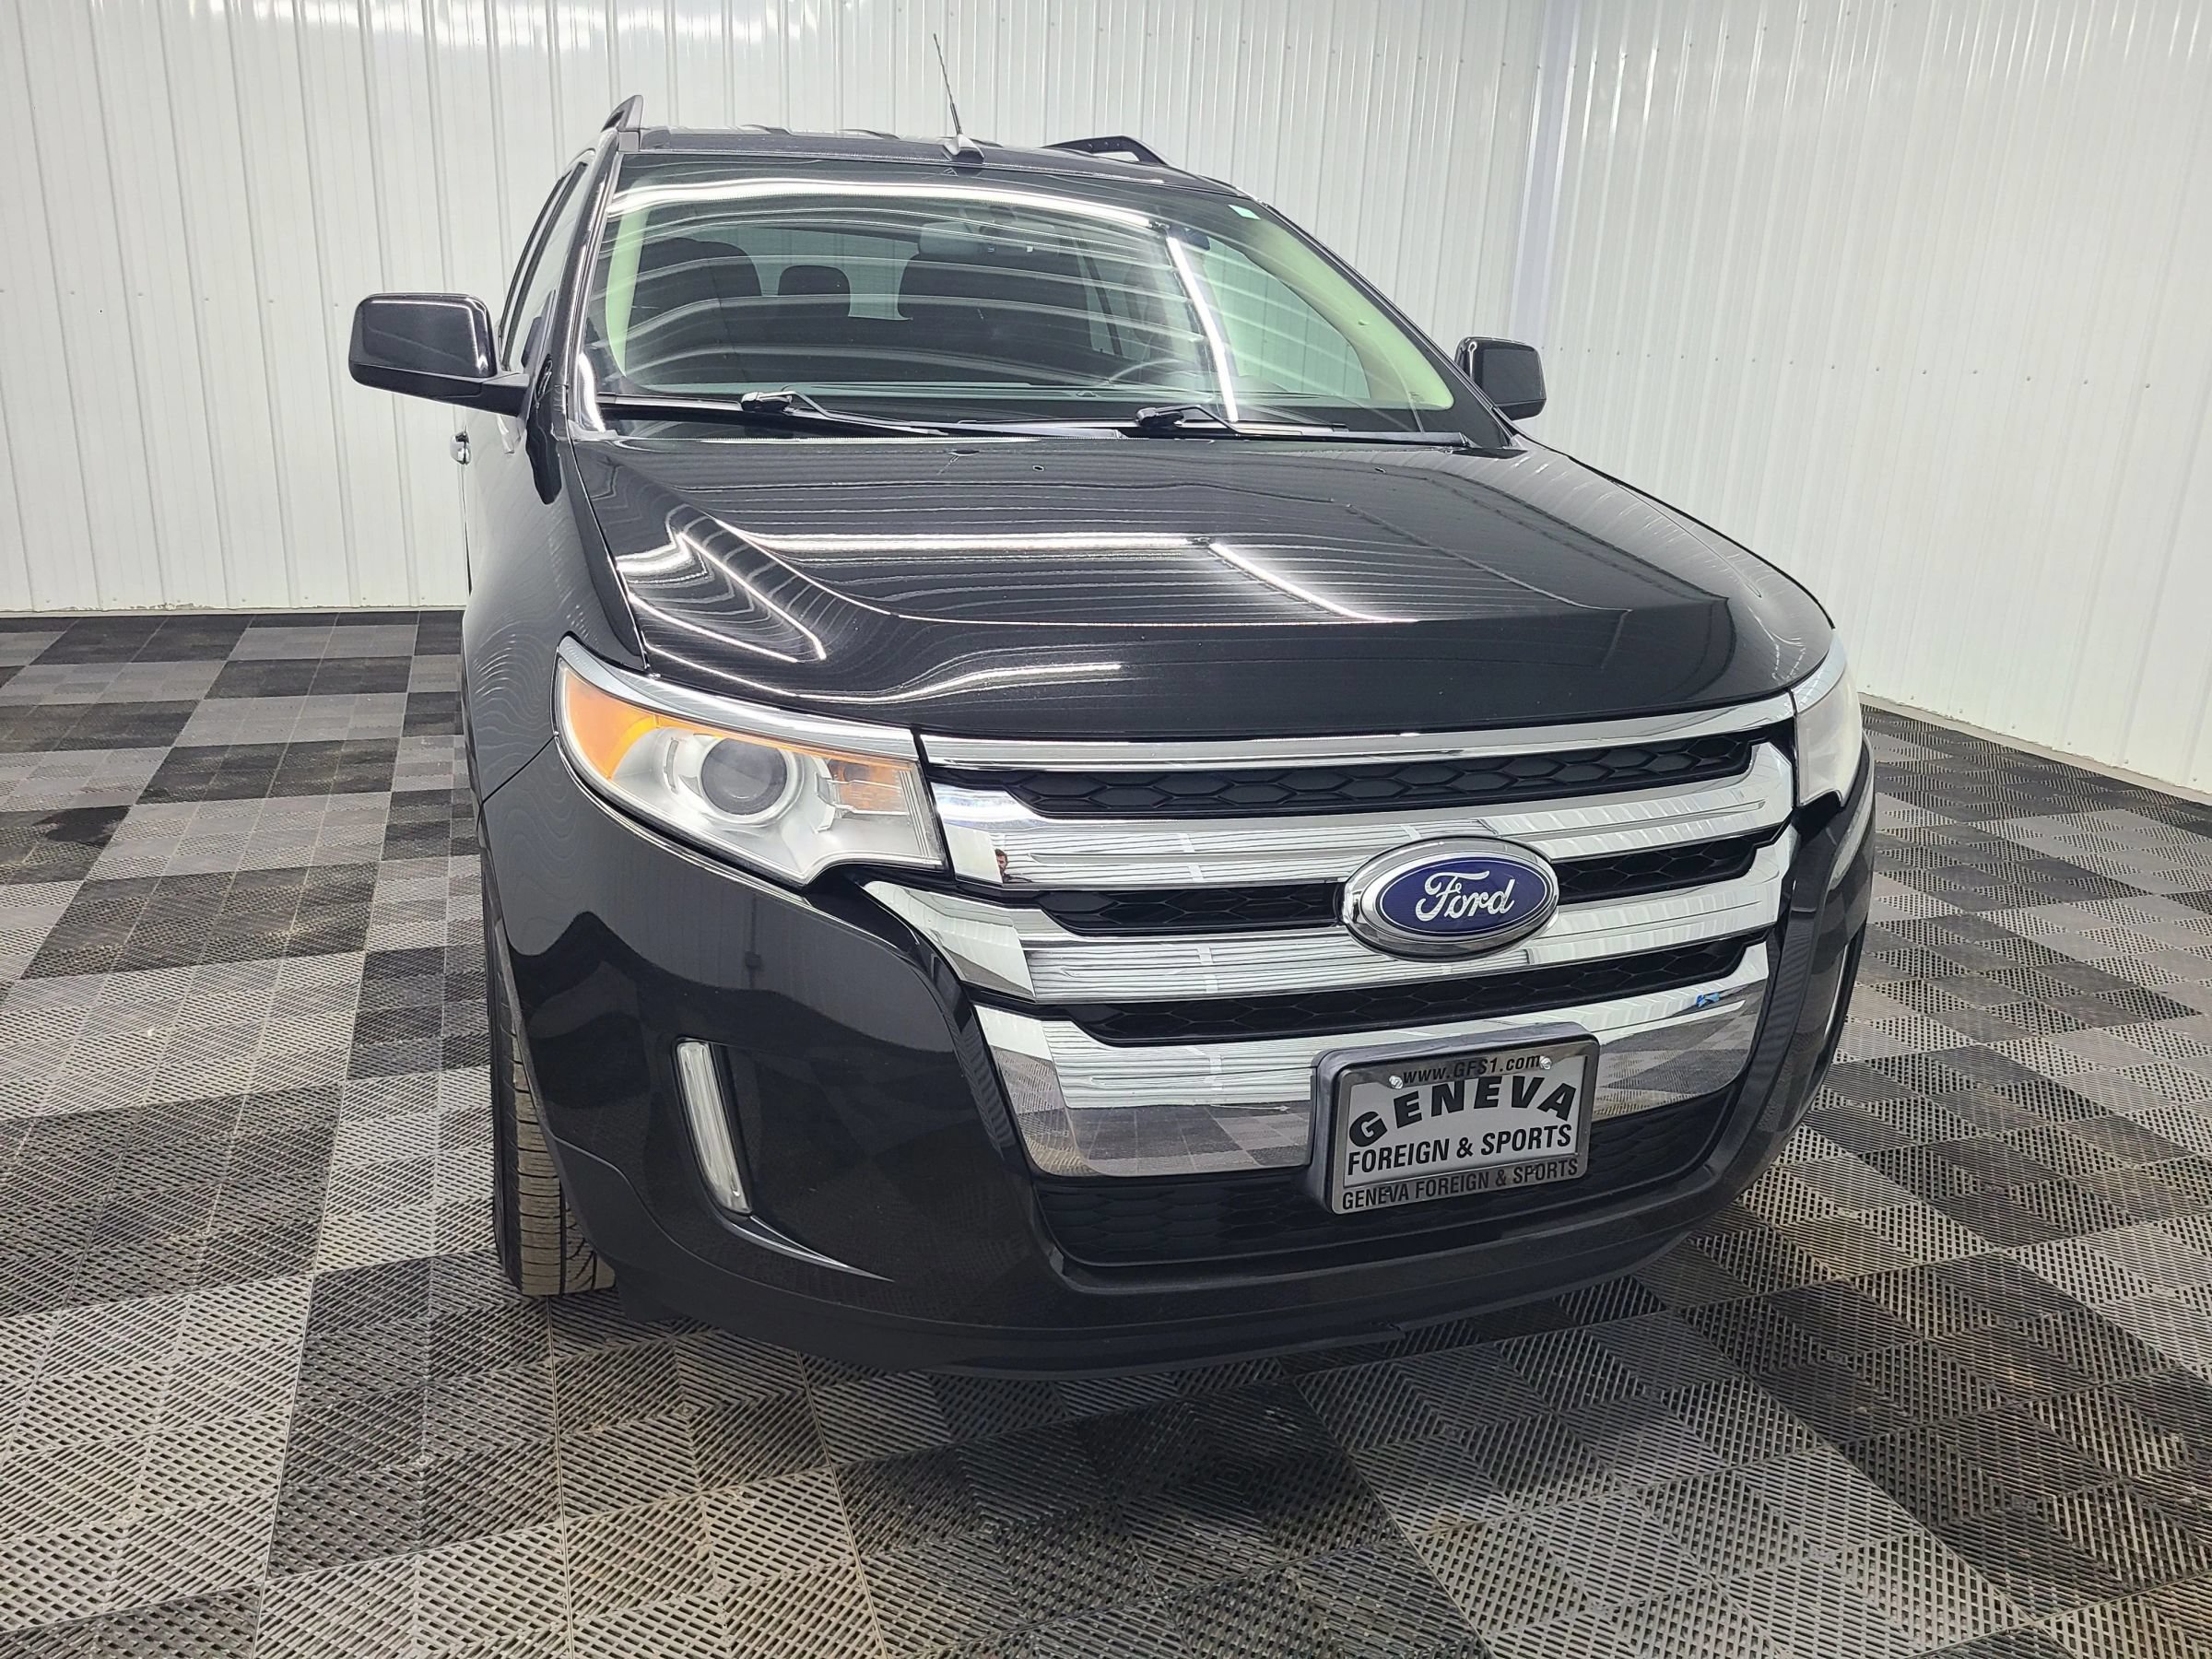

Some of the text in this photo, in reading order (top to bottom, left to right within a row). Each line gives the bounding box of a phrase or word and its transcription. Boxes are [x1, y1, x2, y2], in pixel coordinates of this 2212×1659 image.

[1416, 870, 1515, 922] Ford
[1403, 1054, 1541, 1084] www.GFS1.com
[1349, 1076, 1577, 1147] GENEVA
[1347, 1124, 1572, 1176] FOREIGN & SPORTS
[1342, 1158, 1578, 1210] GENEVA FOREIGN & SPORTS
